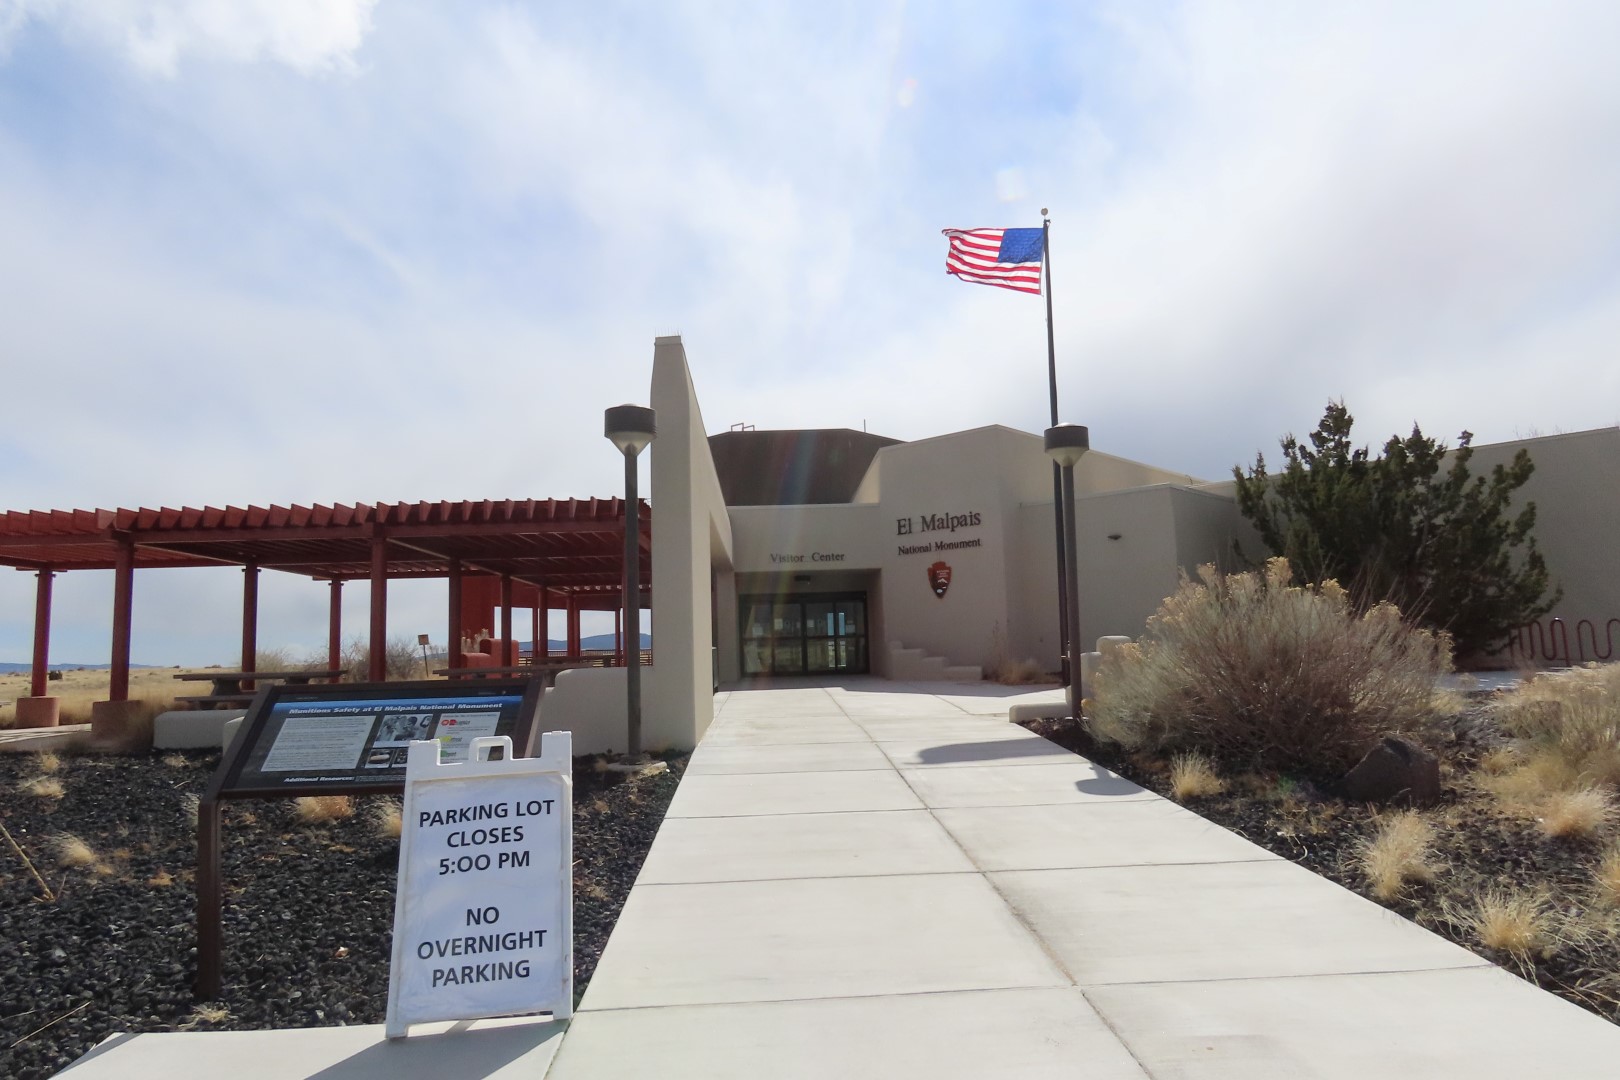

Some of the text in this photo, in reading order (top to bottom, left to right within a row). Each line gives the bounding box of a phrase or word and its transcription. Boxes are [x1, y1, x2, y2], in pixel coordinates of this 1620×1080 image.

[896, 511, 982, 536] El Malpais
[770, 552, 845, 563] Visitor Center
[897, 538, 982, 556] National Monument
[419, 800, 555, 827] PARKING LOT
[447, 826, 524, 848] CLOSES
[439, 850, 530, 876] 5:00 PM
[466, 906, 500, 926] NO
[417, 930, 548, 960] OVERNIGHT
[432, 960, 531, 988] PARKING
